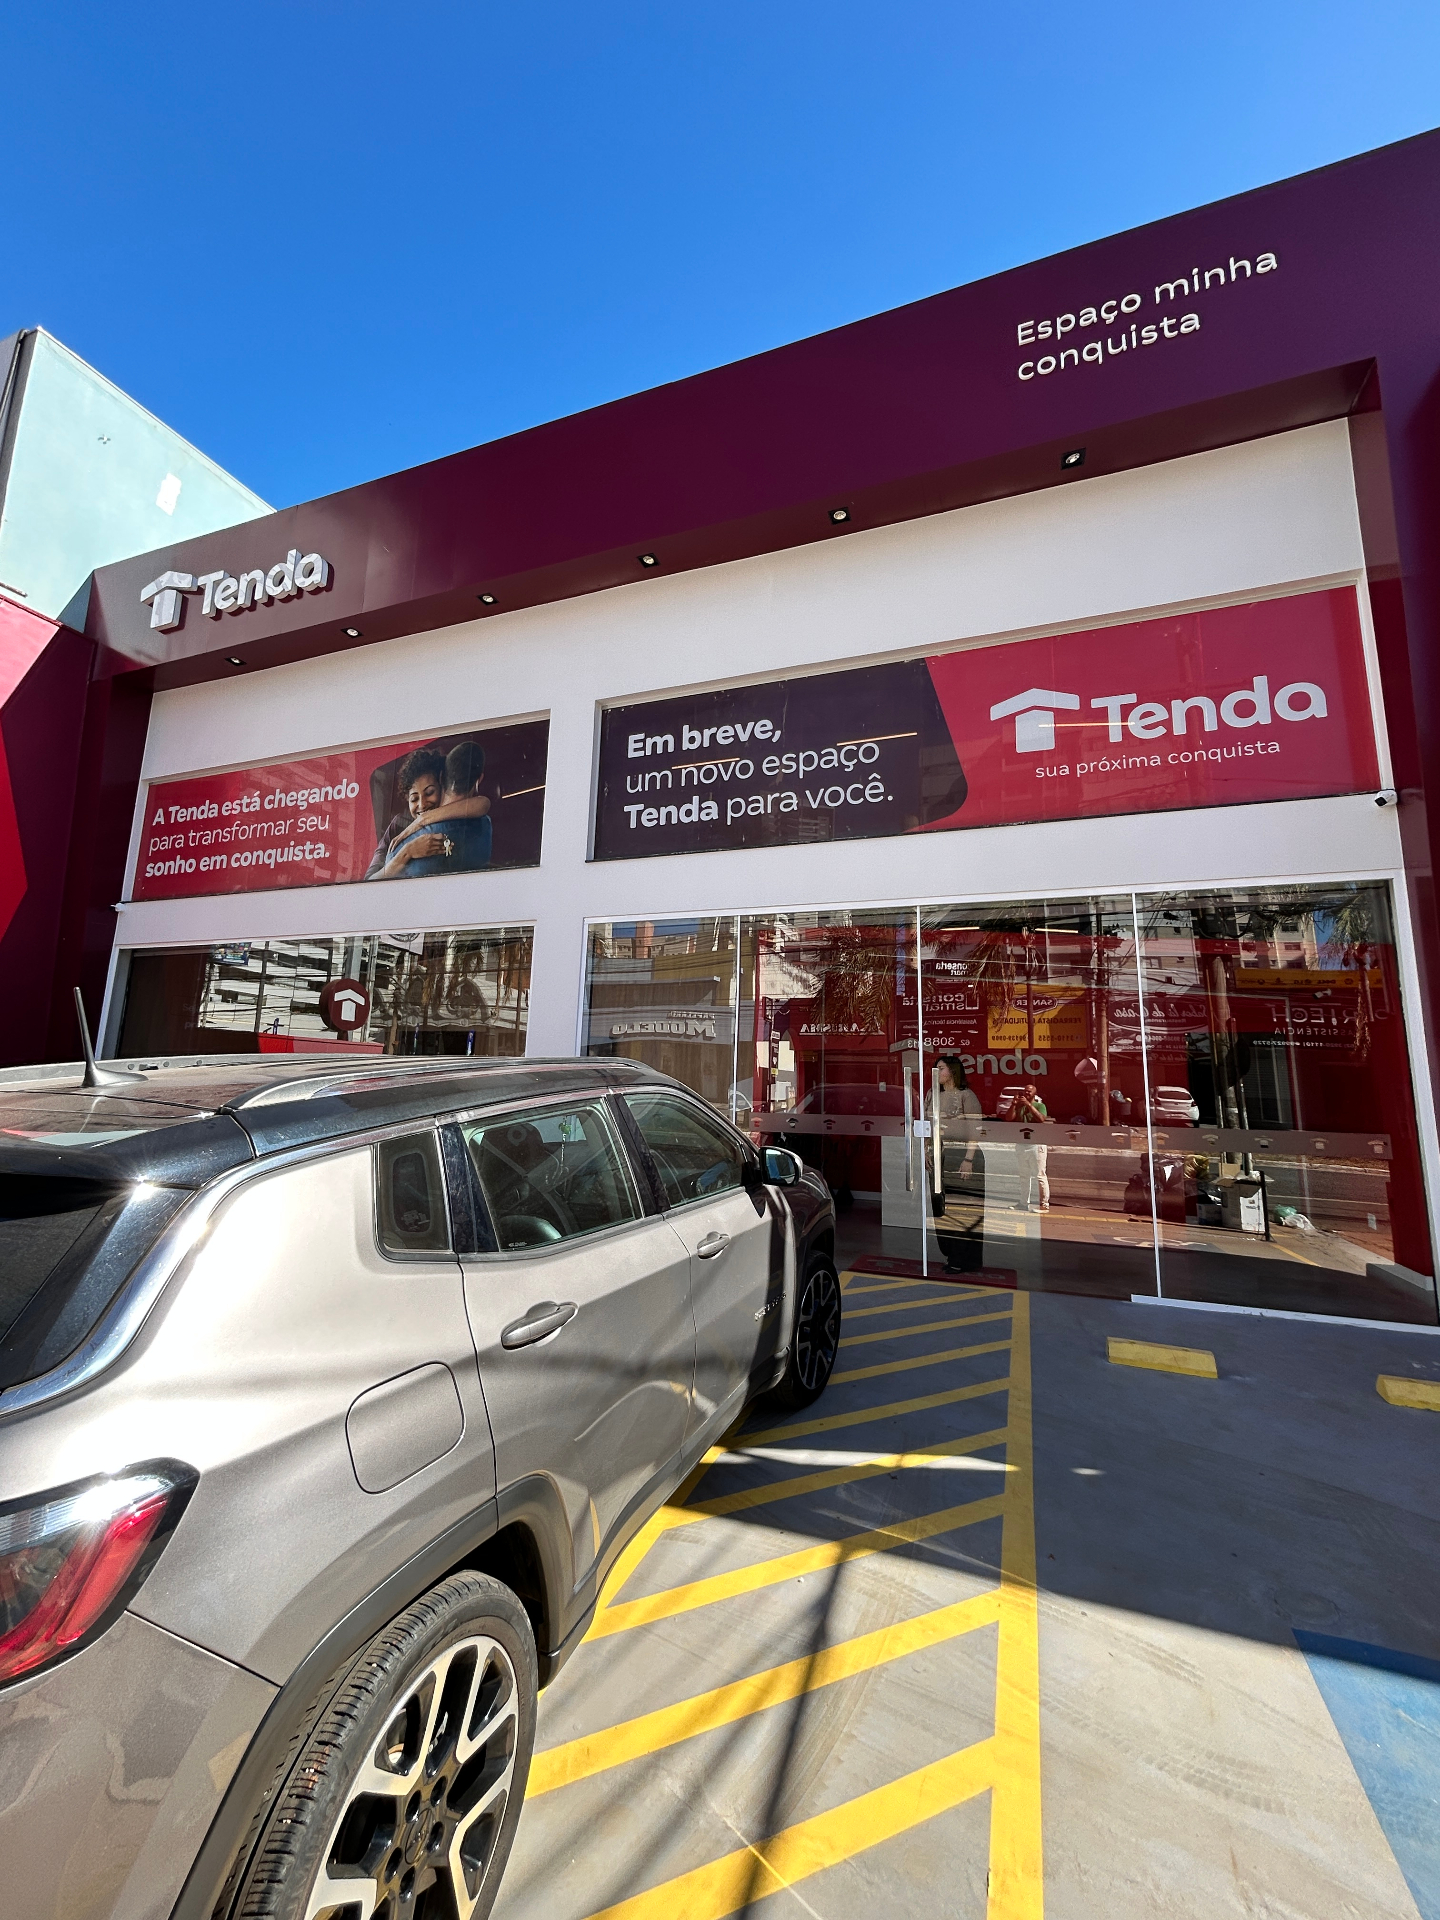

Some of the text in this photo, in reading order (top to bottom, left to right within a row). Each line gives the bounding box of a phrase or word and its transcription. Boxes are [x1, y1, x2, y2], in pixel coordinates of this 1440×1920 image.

[1017, 251, 1278, 346] Espaço minha
[1017, 312, 1201, 381] conquista
[198, 549, 329, 617] Tenda
[1091, 675, 1328, 744] Tenda
[627, 719, 782, 759] Em breve,
[1035, 740, 1281, 778] sua próxima conquista
[626, 742, 881, 794] um novo espaço
[152, 779, 360, 826] A Tenda está chegando
[623, 772, 894, 829] Tenda para você.
[144, 840, 330, 878] sonho em conquista.
[148, 813, 330, 857] para transformar seu
[938, 1047, 1048, 1076] Tenda
